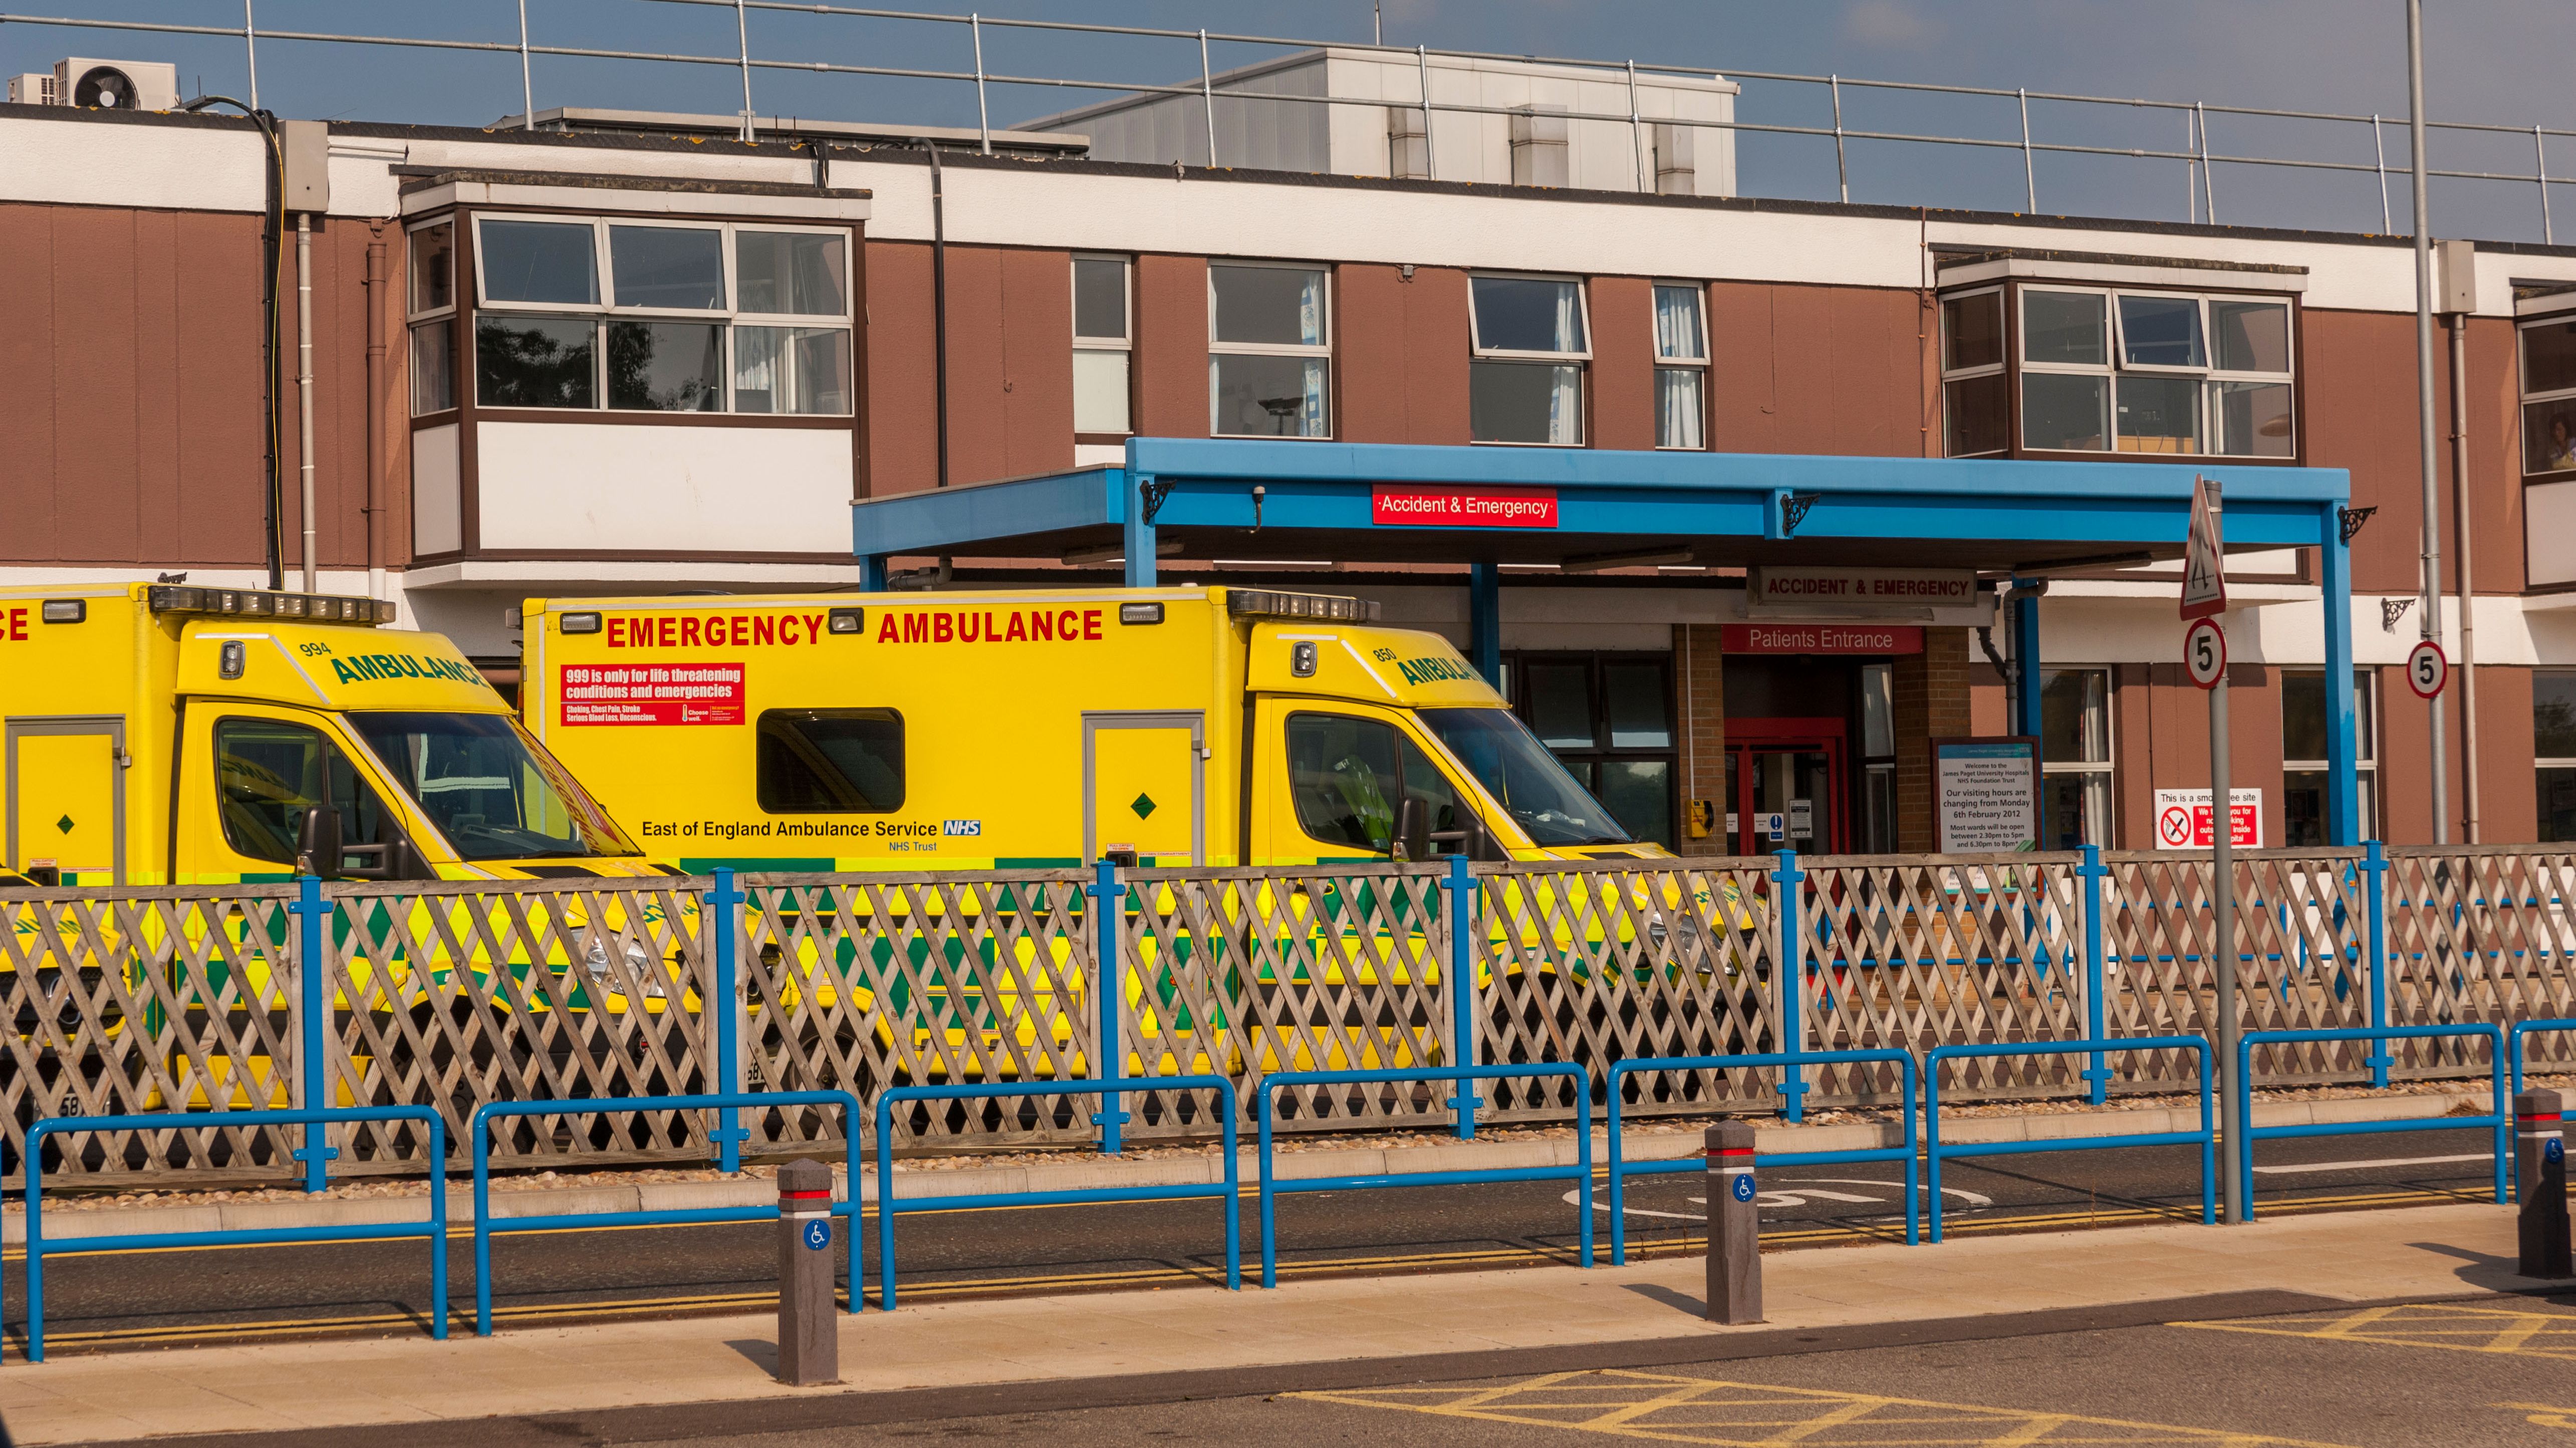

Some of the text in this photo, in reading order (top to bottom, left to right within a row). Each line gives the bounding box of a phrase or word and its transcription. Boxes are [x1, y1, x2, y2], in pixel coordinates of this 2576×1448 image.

[1382, 496, 1549, 518] Accident & Emergency
[1768, 579, 1968, 596] ACCIDENT & EMERGENCY
[608, 610, 1103, 647] EMERGENCY AMBULANCE
[1750, 629, 1893, 648] Patients Entrance
[300, 642, 332, 657] 994
[1373, 647, 1397, 662] 850
[2197, 635, 2213, 672] 5
[566, 668, 740, 683] 999 is only for life threatening
[2419, 656, 2434, 684] 5
[566, 684, 732, 699] conditions and emergencies
[567, 705, 590, 713] Choking,
[591, 705, 607, 713] Chest
[622, 705, 640, 713] Stroke
[589, 713, 605, 721] Blood
[1963, 789, 1990, 798] visiting
[2180, 794, 2186, 802] is
[2243, 793, 2256, 801] site
[1943, 800, 1978, 808] changing
[2000, 799, 2030, 808] Monday
[1968, 811, 2001, 819] February
[643, 821, 980, 840] East of England Ambulance Service NHS
[889, 842, 937, 851] NHS Trust
